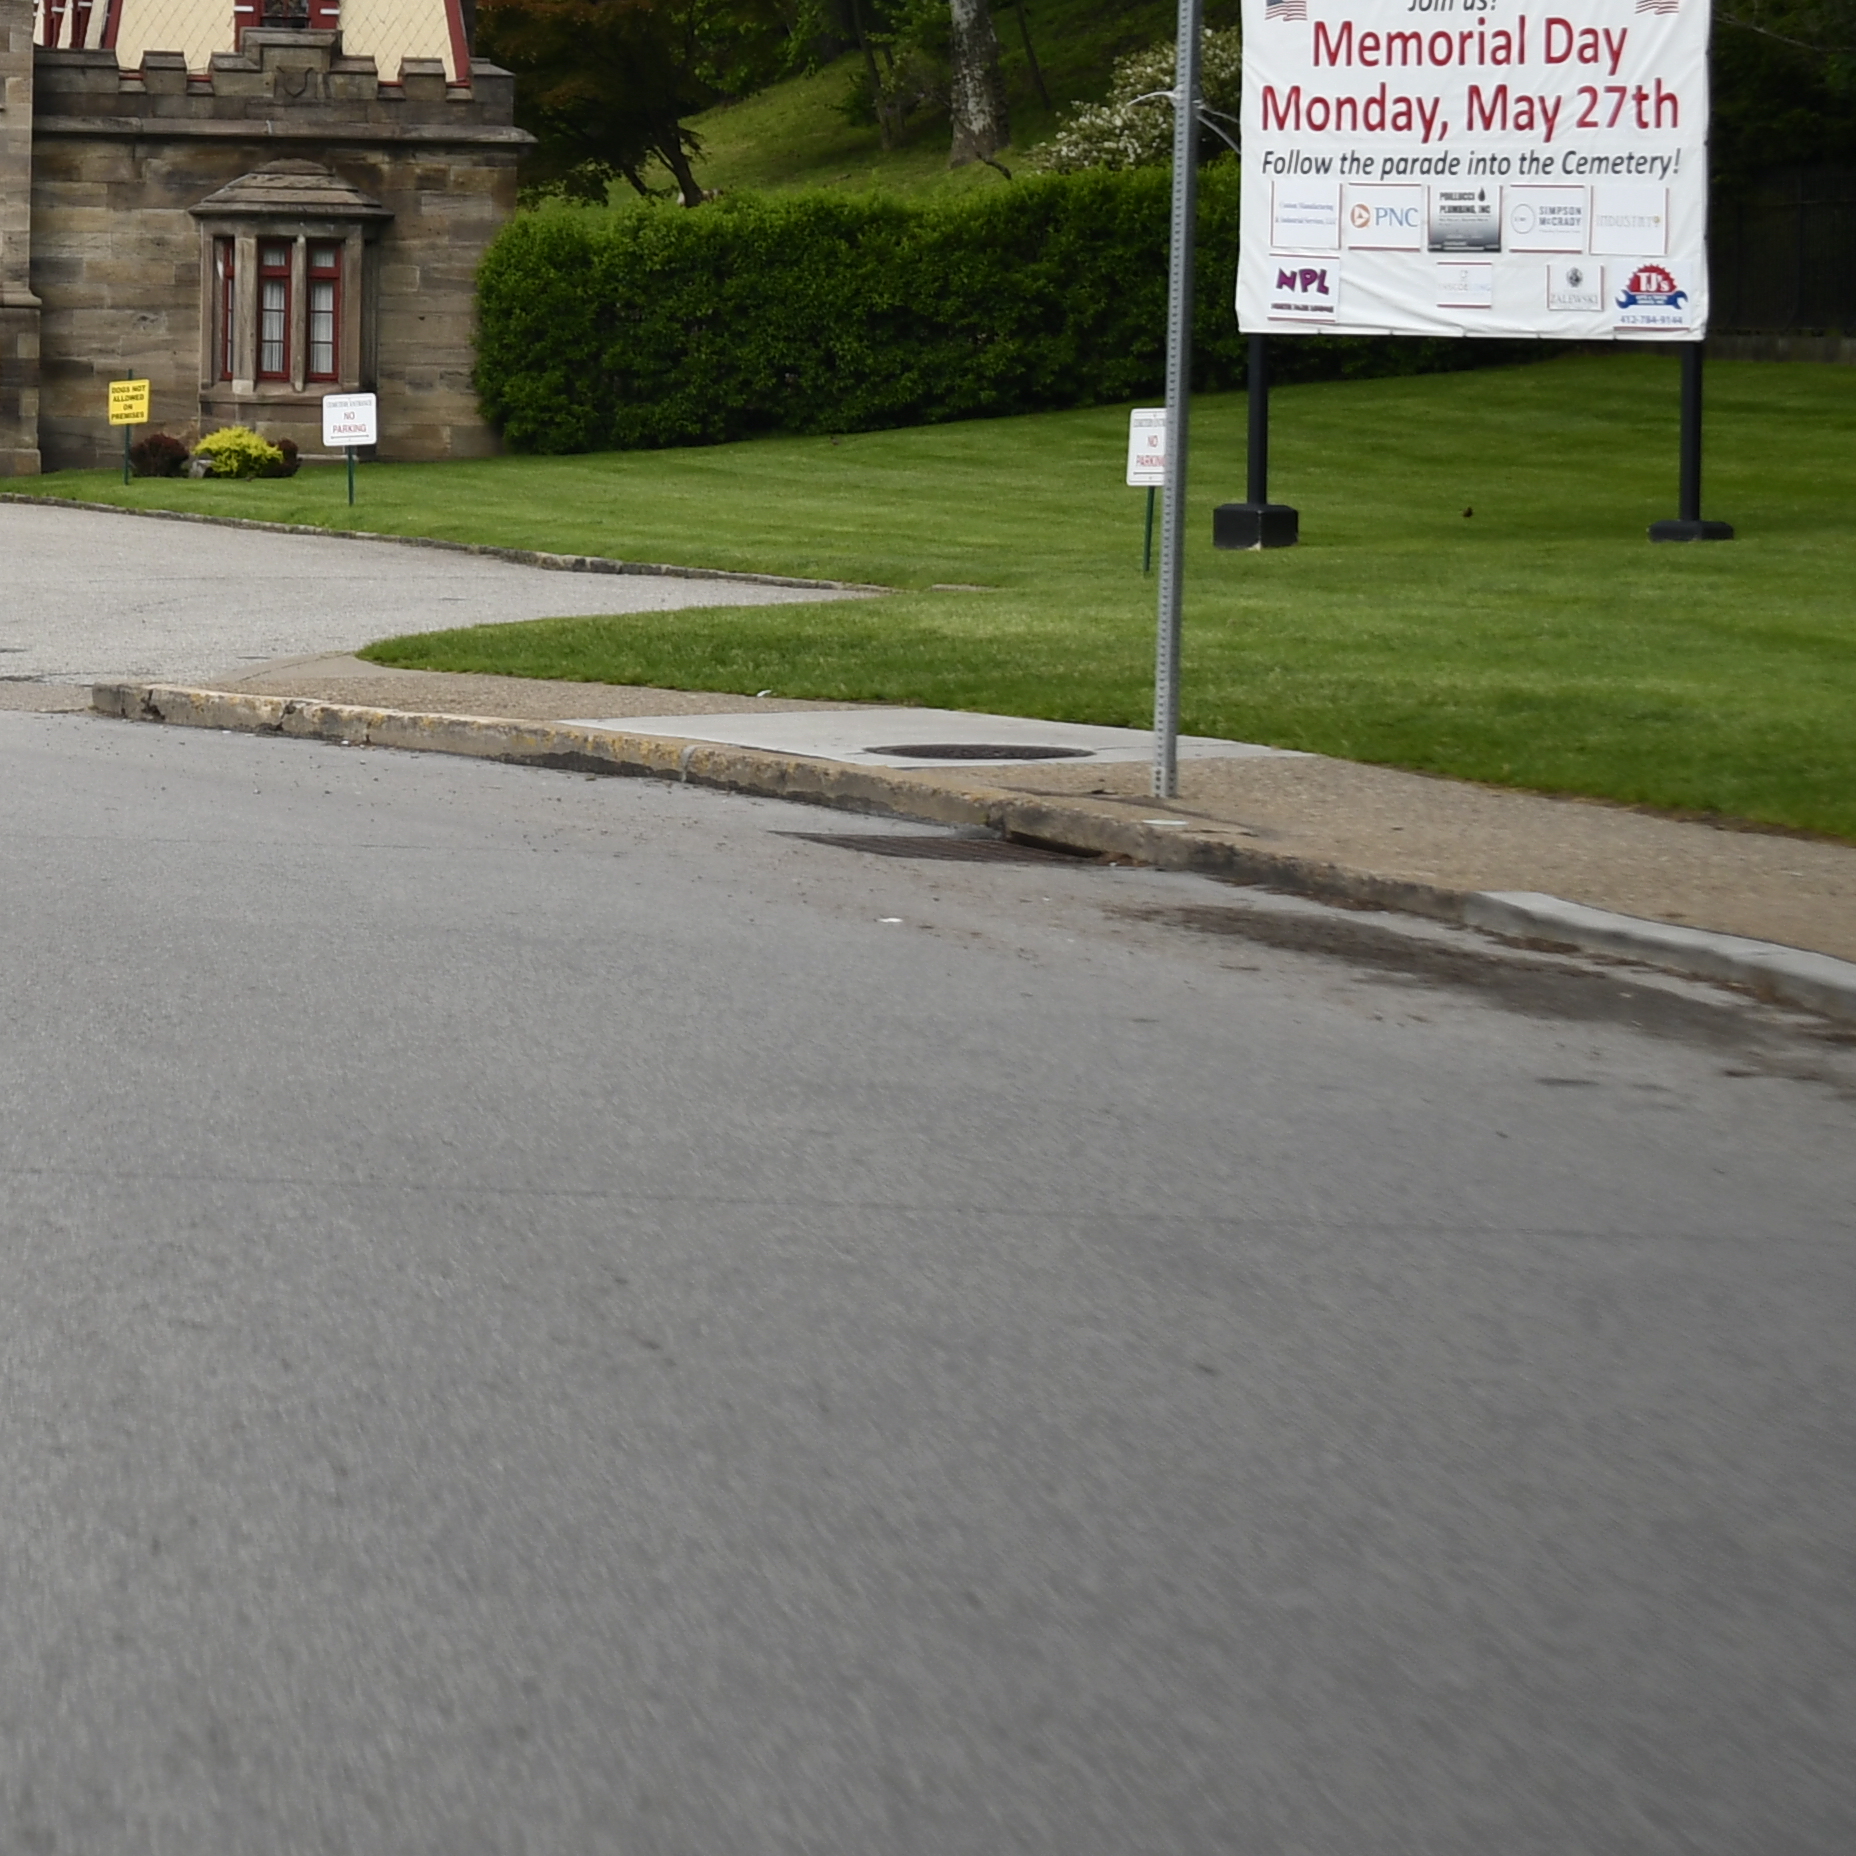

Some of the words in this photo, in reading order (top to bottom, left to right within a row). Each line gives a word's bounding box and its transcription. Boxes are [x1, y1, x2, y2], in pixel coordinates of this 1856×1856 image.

[1312, 14, 1526, 67] Memorial
[1544, 17, 1628, 76] Day
[1262, 81, 1448, 144] Monday,
[1466, 84, 1562, 143] May
[1576, 77, 1678, 130] 27th
[1262, 149, 1333, 175] Follow
[1339, 149, 1374, 175] the
[1380, 149, 1460, 181] parade
[1467, 150, 1511, 176] into
[1518, 149, 1555, 175] the
[1562, 148, 1682, 181] Cemetery!
[1375, 207, 1419, 227] PNC
[1539, 206, 1582, 216] SIMPSON
[1275, 268, 1330, 295] NPL
[343, 411, 355, 420] NO
[332, 424, 367, 433] PARKING
